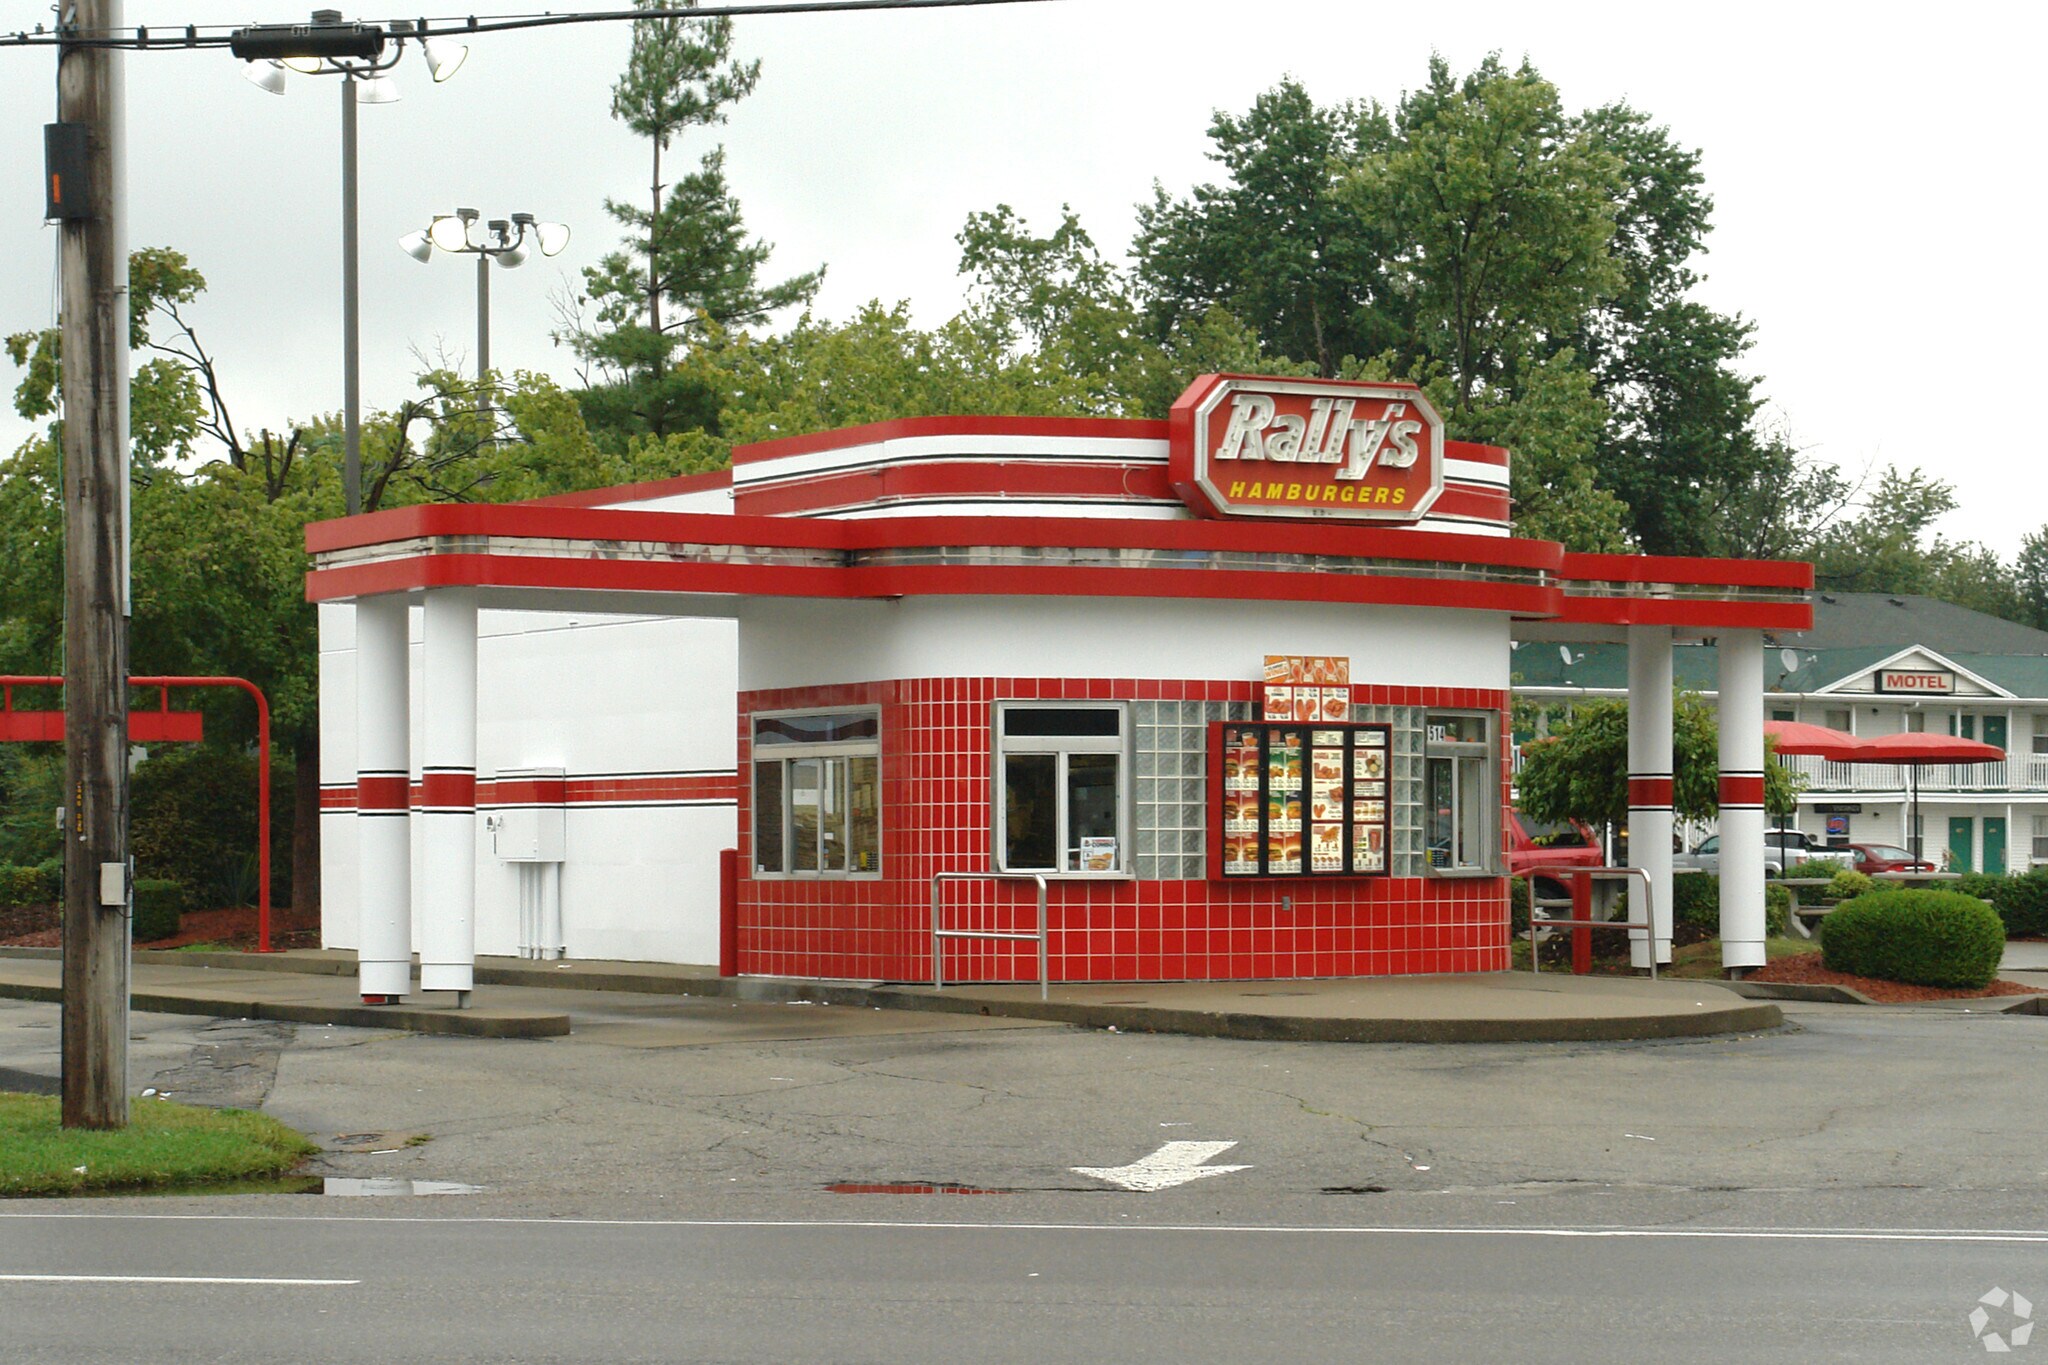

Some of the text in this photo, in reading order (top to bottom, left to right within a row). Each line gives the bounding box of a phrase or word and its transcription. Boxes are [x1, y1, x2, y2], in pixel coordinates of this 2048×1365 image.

[1215, 394, 1422, 480] Rally's
[1229, 481, 1406, 504] HAMBURGERS
[1887, 674, 1947, 689] MOTEL
[1429, 725, 1444, 741] 514
